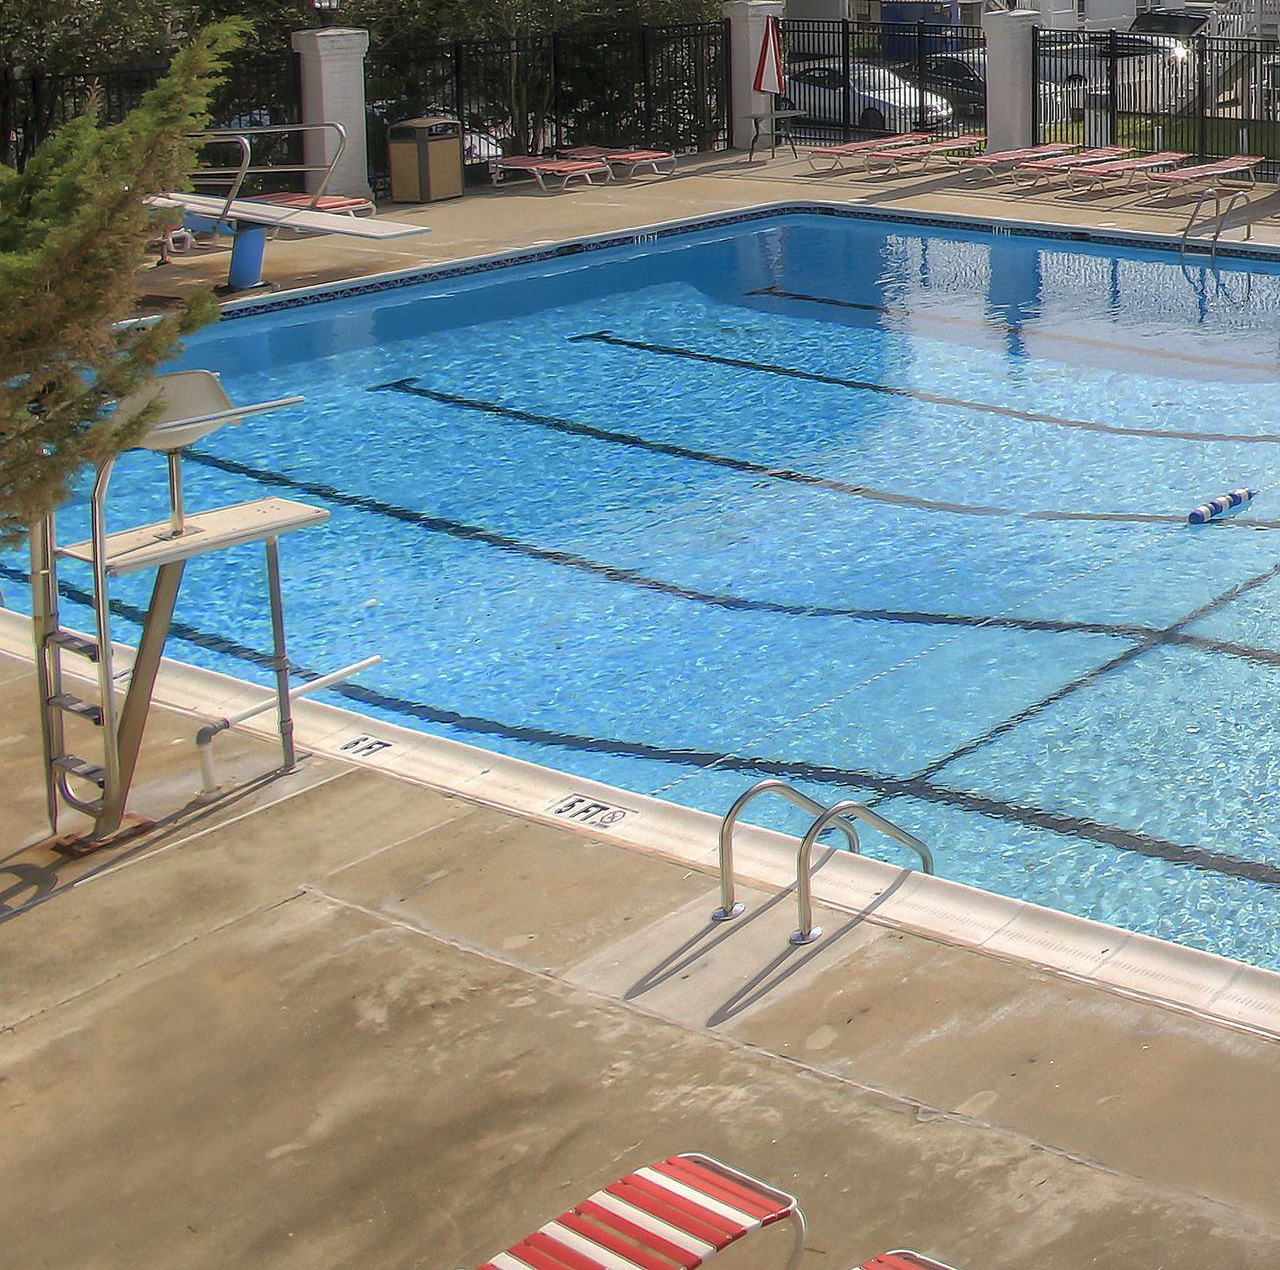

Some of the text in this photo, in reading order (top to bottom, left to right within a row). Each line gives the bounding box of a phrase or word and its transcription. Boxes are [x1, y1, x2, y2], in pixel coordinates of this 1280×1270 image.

[340, 737, 392, 756] 6 FT
[554, 798, 610, 821] 5 FT
